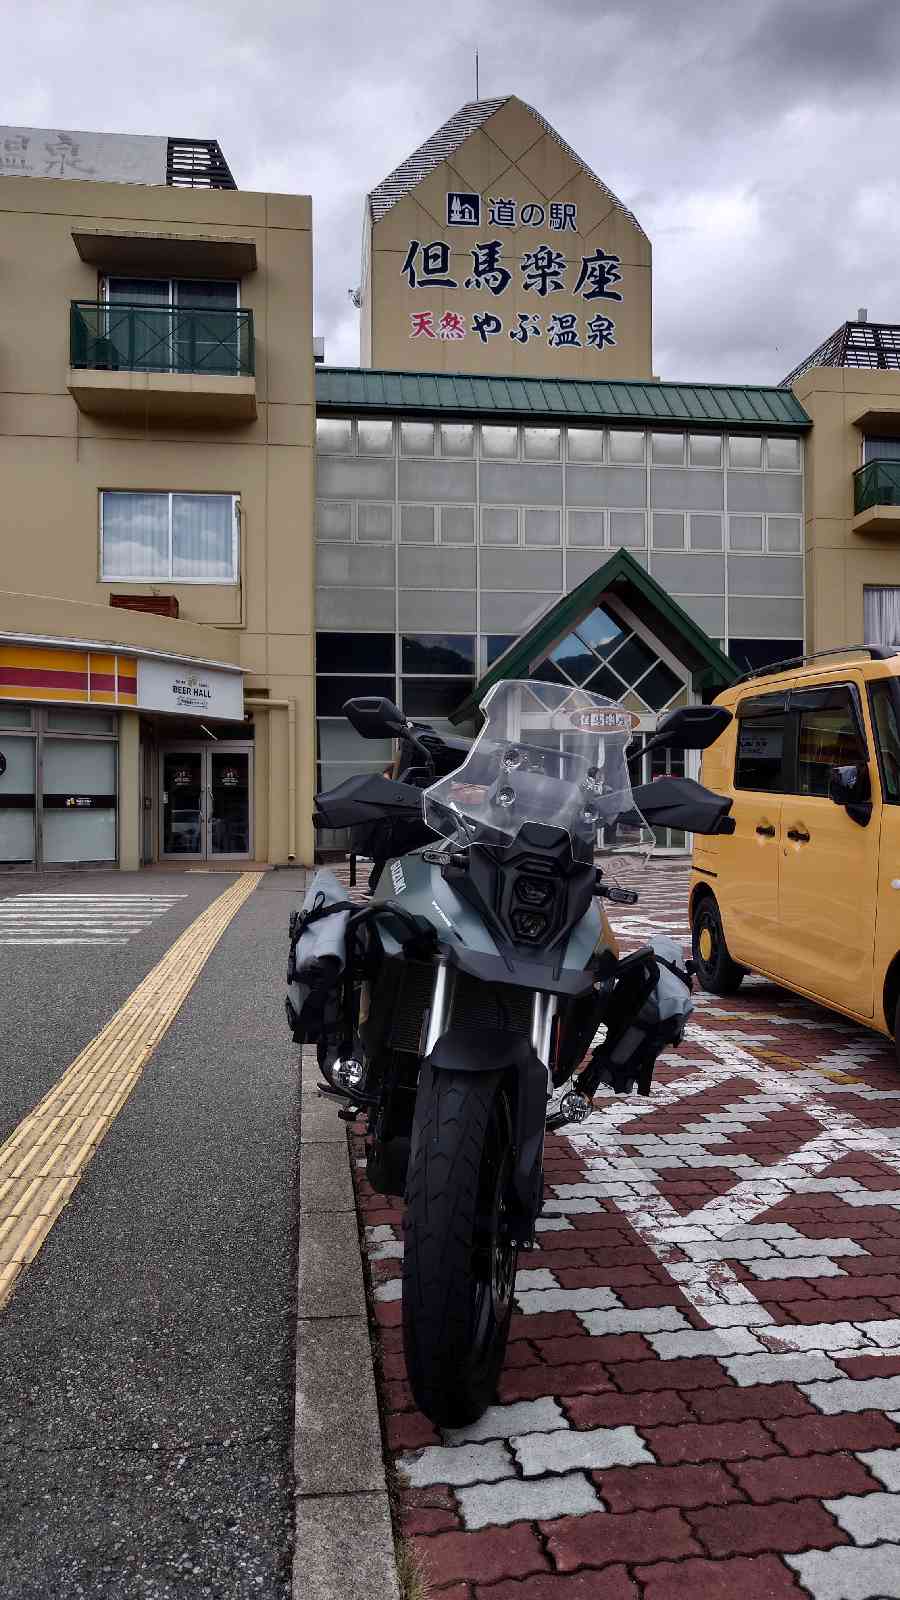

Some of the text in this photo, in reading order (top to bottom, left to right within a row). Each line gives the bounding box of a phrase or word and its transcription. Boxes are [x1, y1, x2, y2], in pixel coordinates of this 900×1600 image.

[487, 198, 577, 231] 道の駅
[401, 240, 623, 301] 但馬楽座
[172, 685, 191, 696] BEER
[193, 688, 211, 699] HALL
[390, 860, 407, 896] SUZUKI
